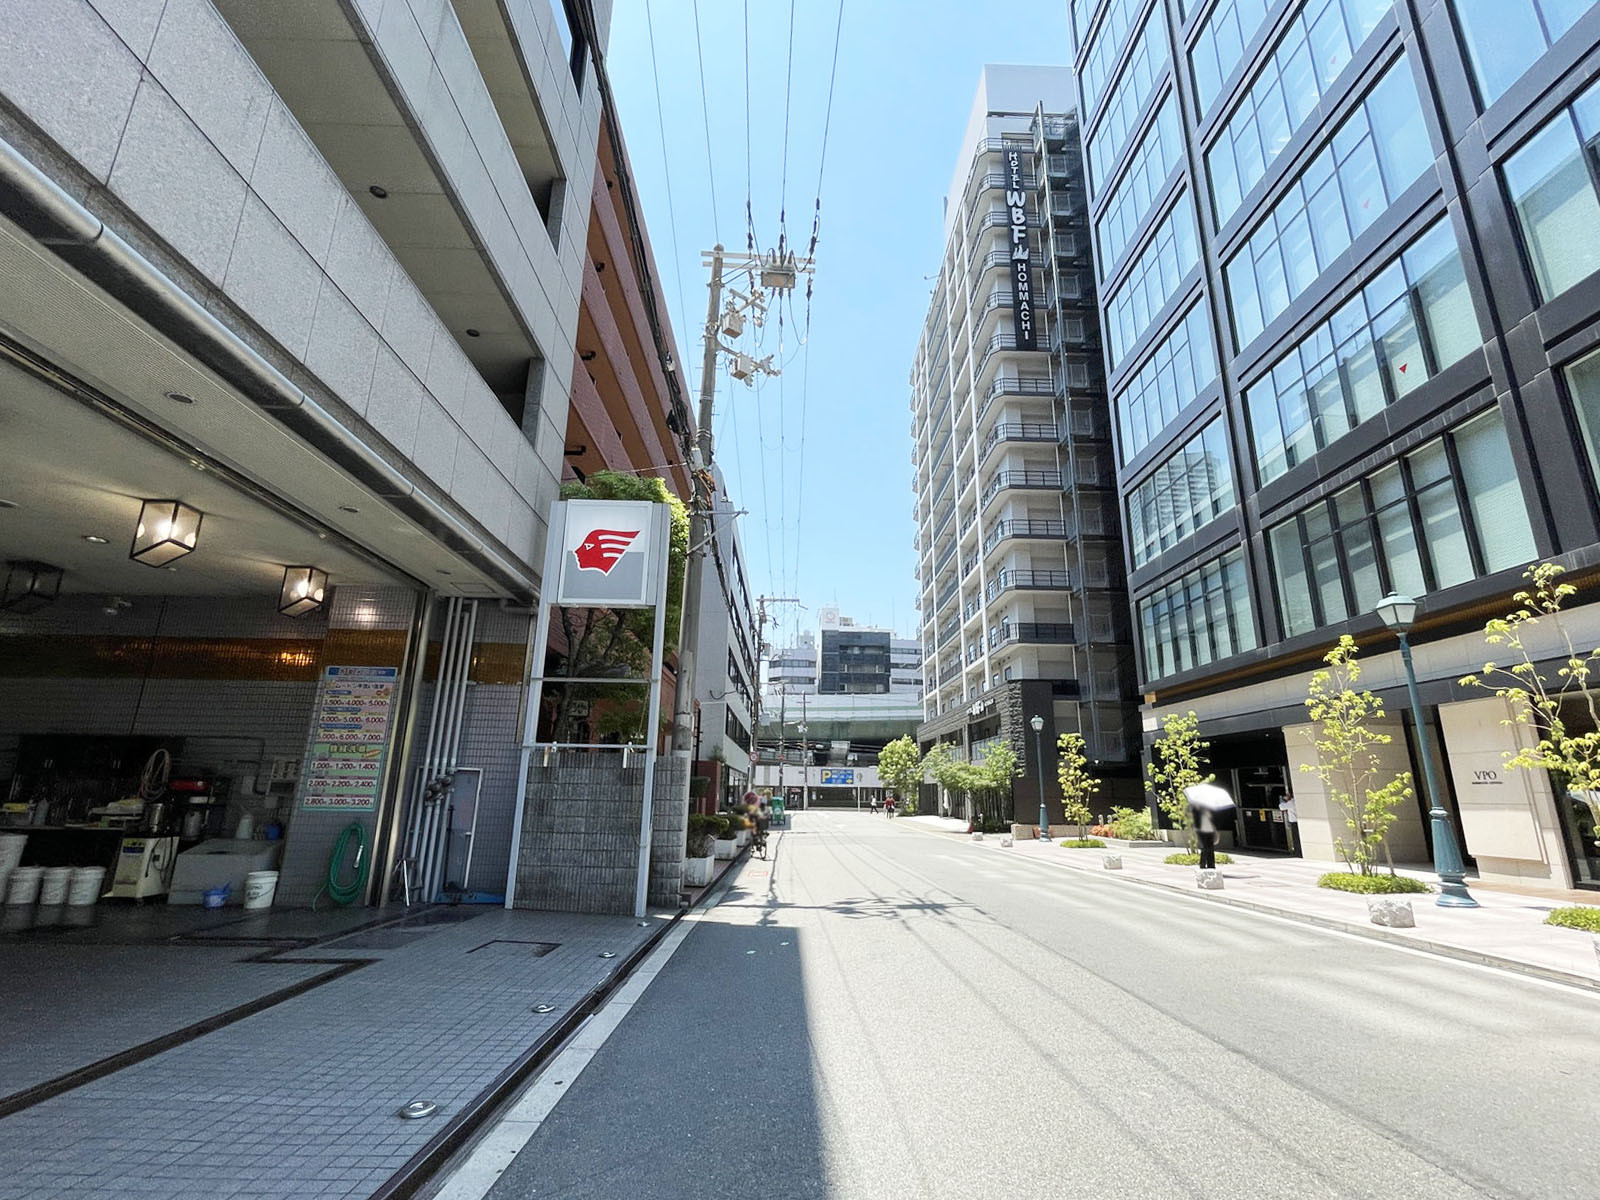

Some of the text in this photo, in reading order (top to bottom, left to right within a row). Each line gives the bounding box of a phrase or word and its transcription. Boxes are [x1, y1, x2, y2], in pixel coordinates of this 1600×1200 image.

[1006, 190, 1027, 244] WBF
[1017, 263, 1031, 340] HOMMACHI
[822, 770, 832, 783] P
[1473, 770, 1497, 780] VPO
